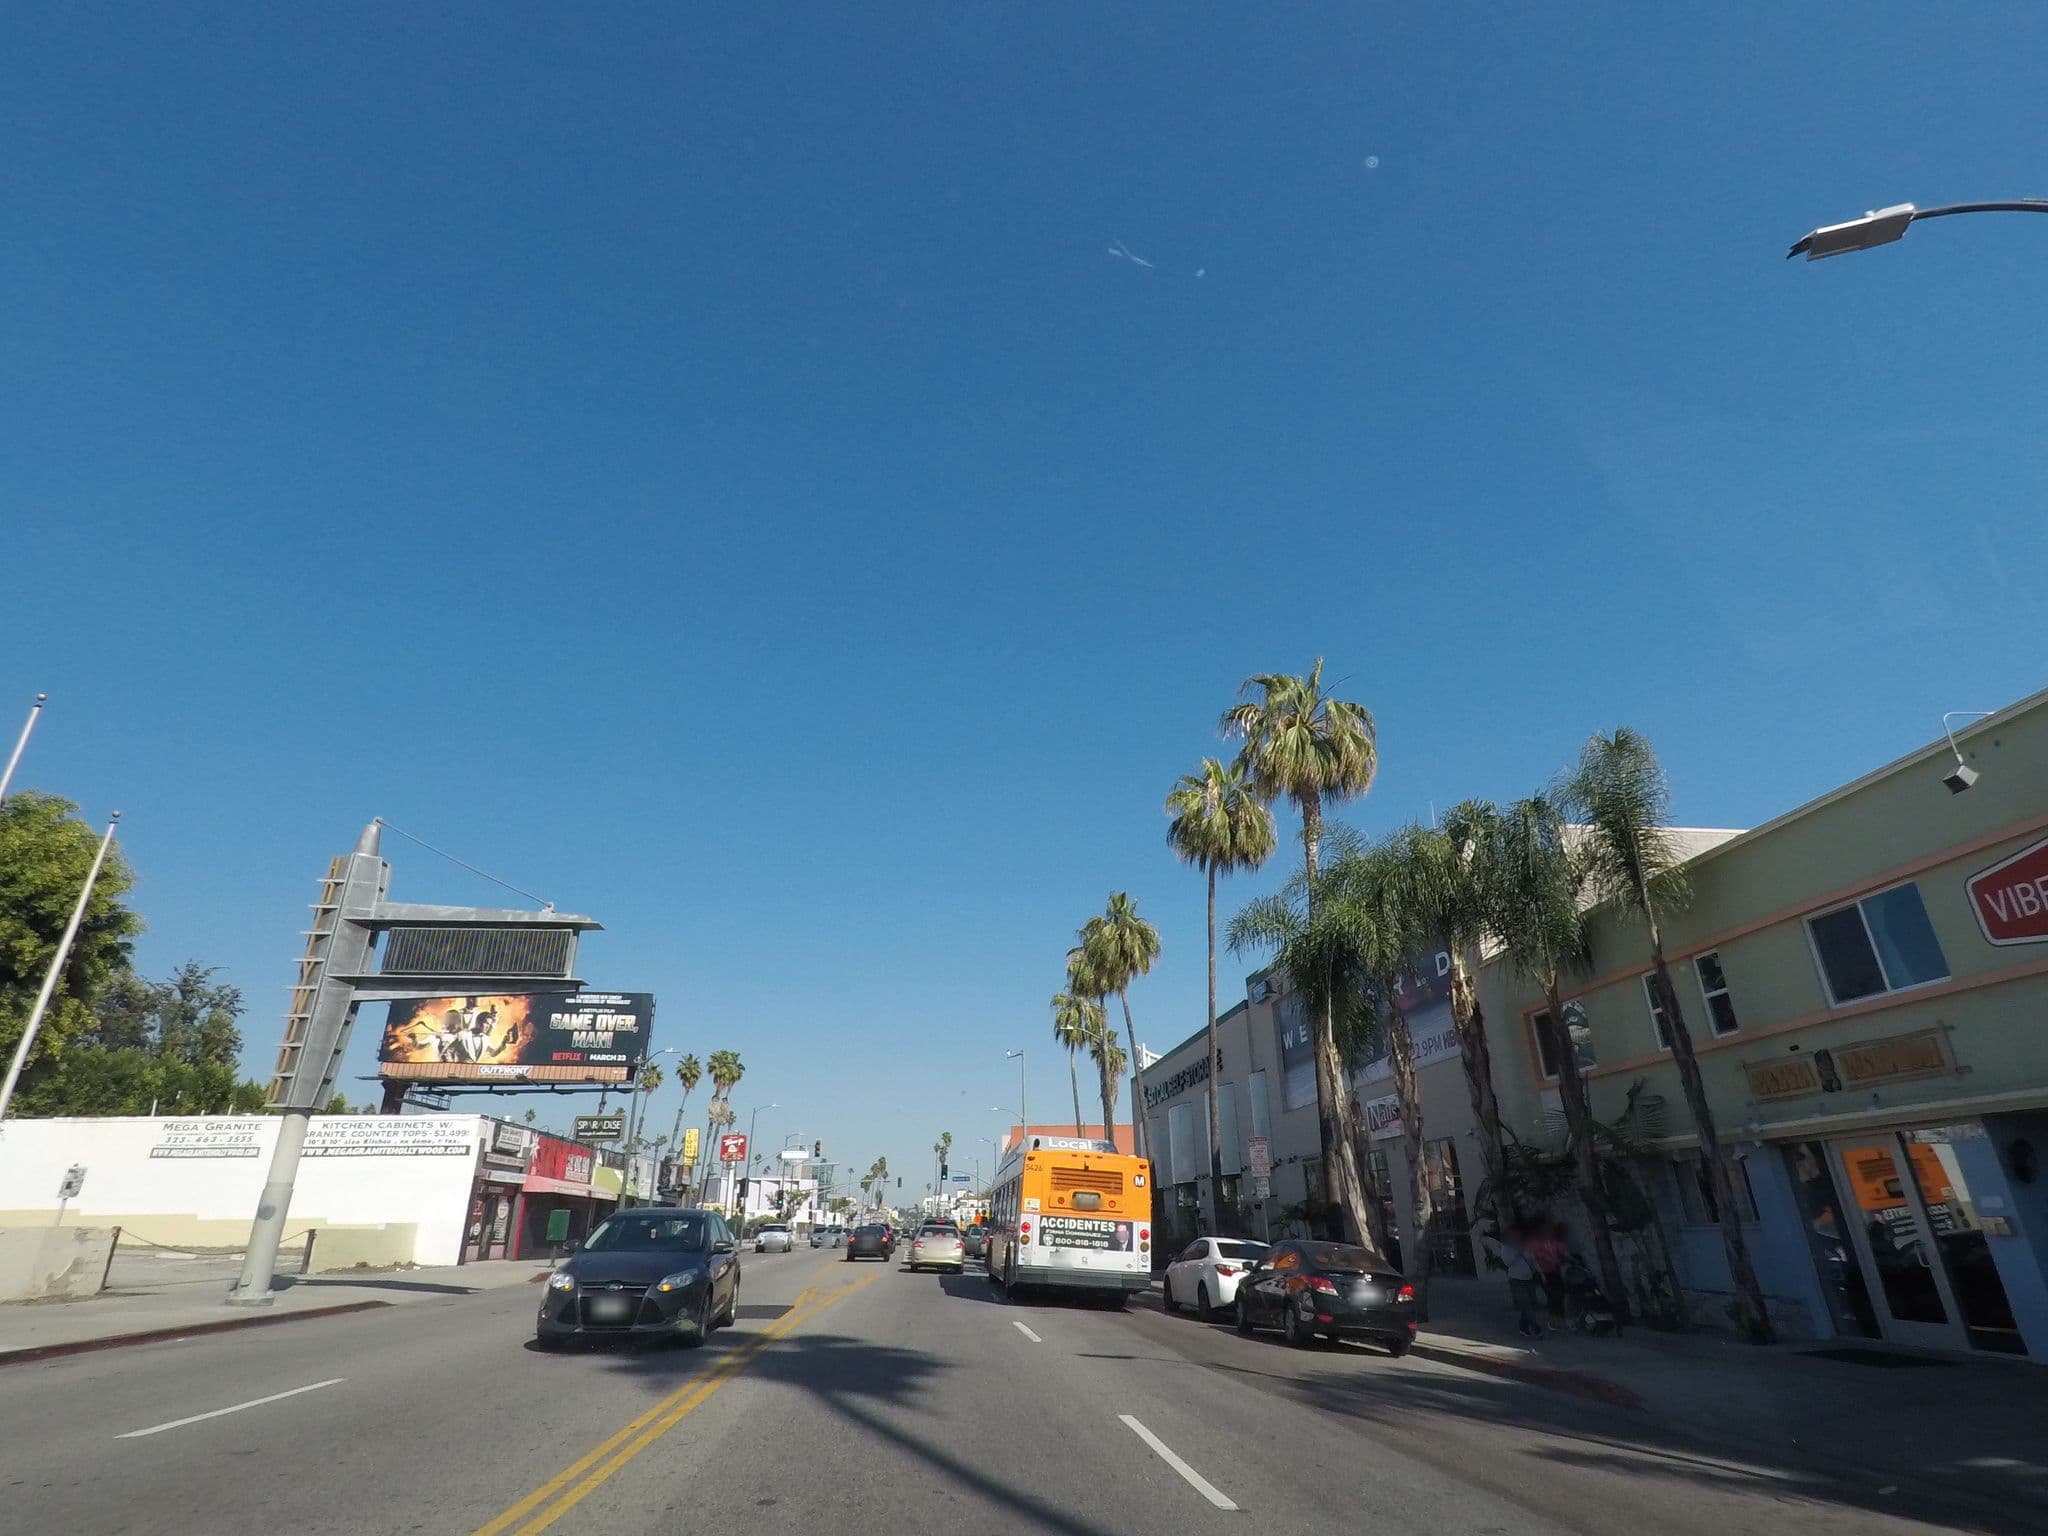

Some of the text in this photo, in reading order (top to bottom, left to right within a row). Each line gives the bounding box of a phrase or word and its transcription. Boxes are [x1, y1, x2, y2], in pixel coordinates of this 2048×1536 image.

[550, 1013, 593, 1030] GAME
[571, 1031, 614, 1048] MAN!
[552, 1052, 581, 1060] NETFLIX
[480, 1066, 529, 1075] OUTFRONT
[1368, 1103, 1400, 1131] Nails
[163, 1123, 262, 1131] MEGA GRANITE
[1048, 1137, 1092, 1150] Local
[1134, 1176, 1145, 1186] M
[1040, 1218, 1115, 1232] ACCIDENTES
